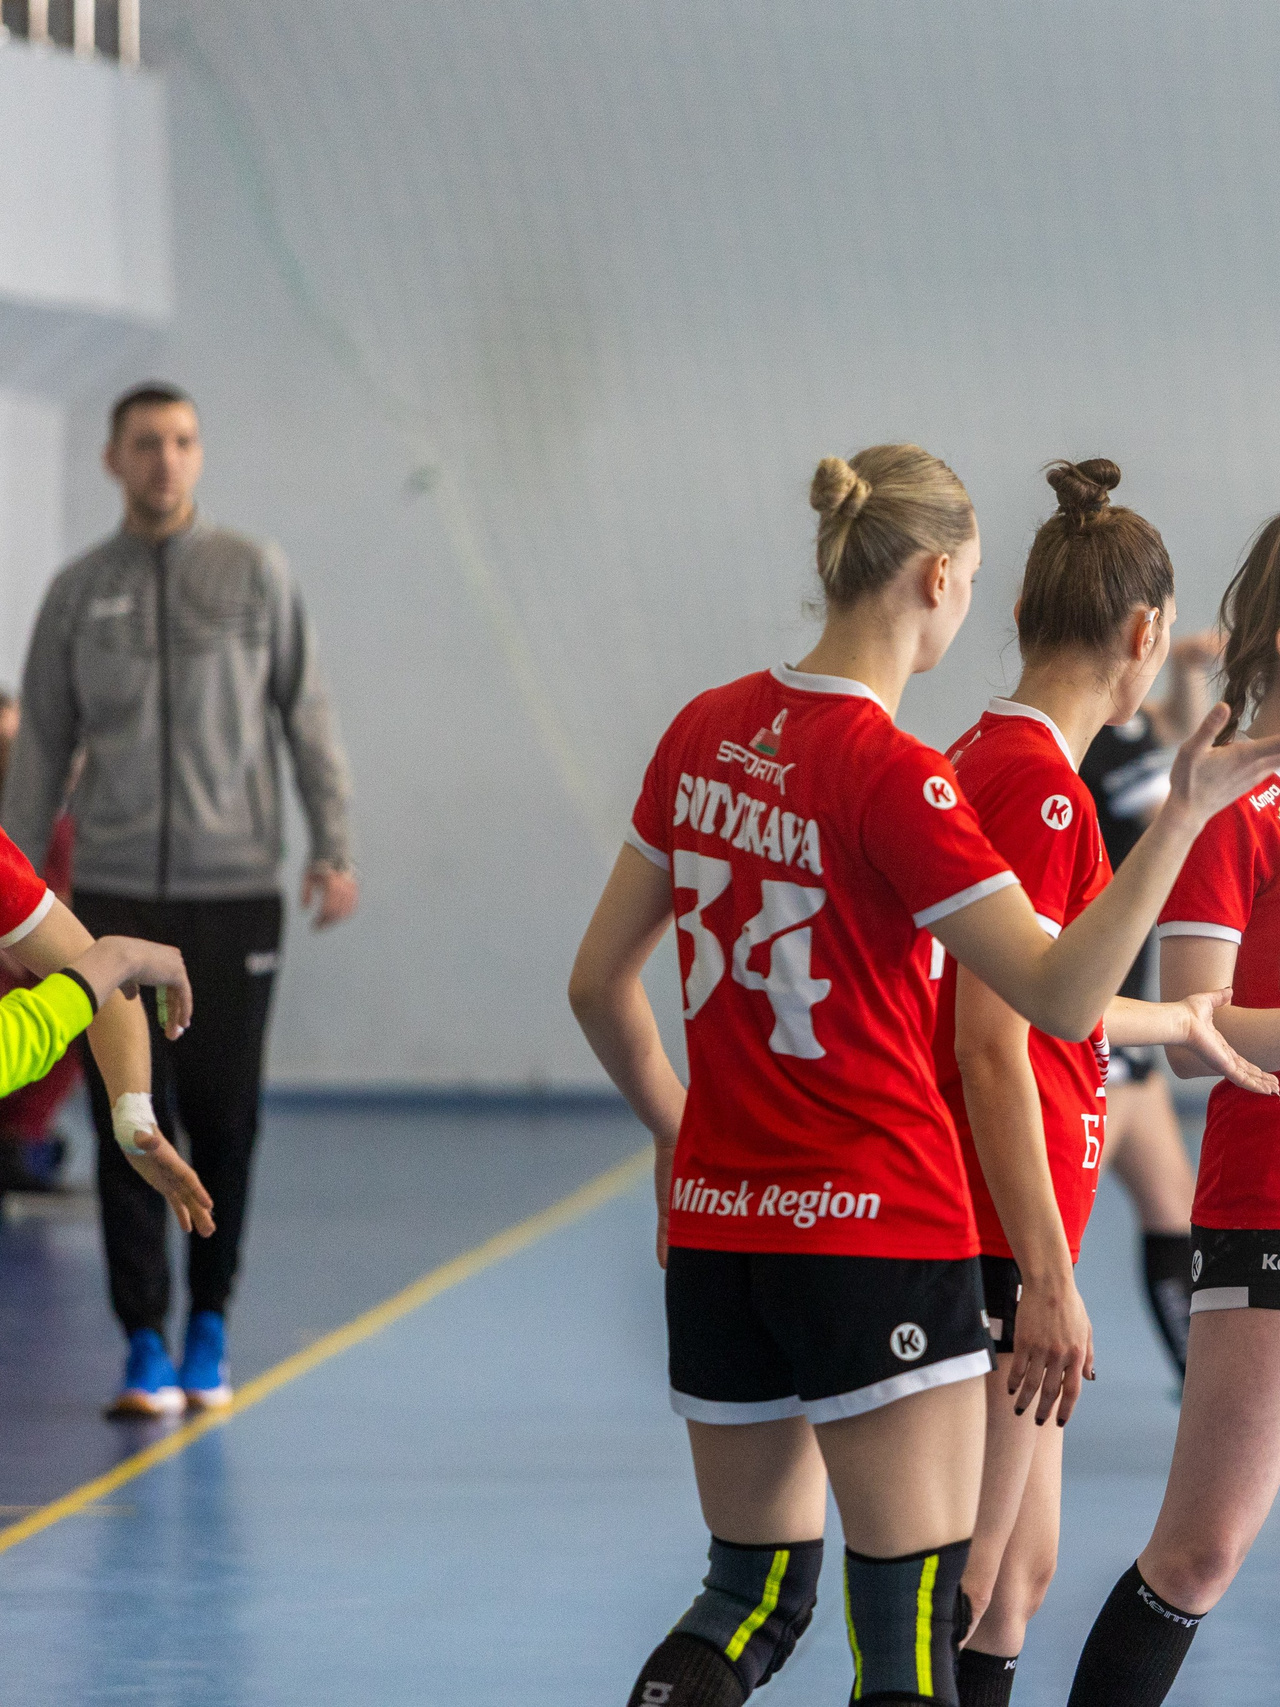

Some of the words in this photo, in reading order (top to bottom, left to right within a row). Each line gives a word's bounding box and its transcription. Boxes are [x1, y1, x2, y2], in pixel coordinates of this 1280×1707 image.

[673, 849, 832, 1059] 34
[671, 1177, 754, 1217] Minsk
[757, 1181, 881, 1229] Region
